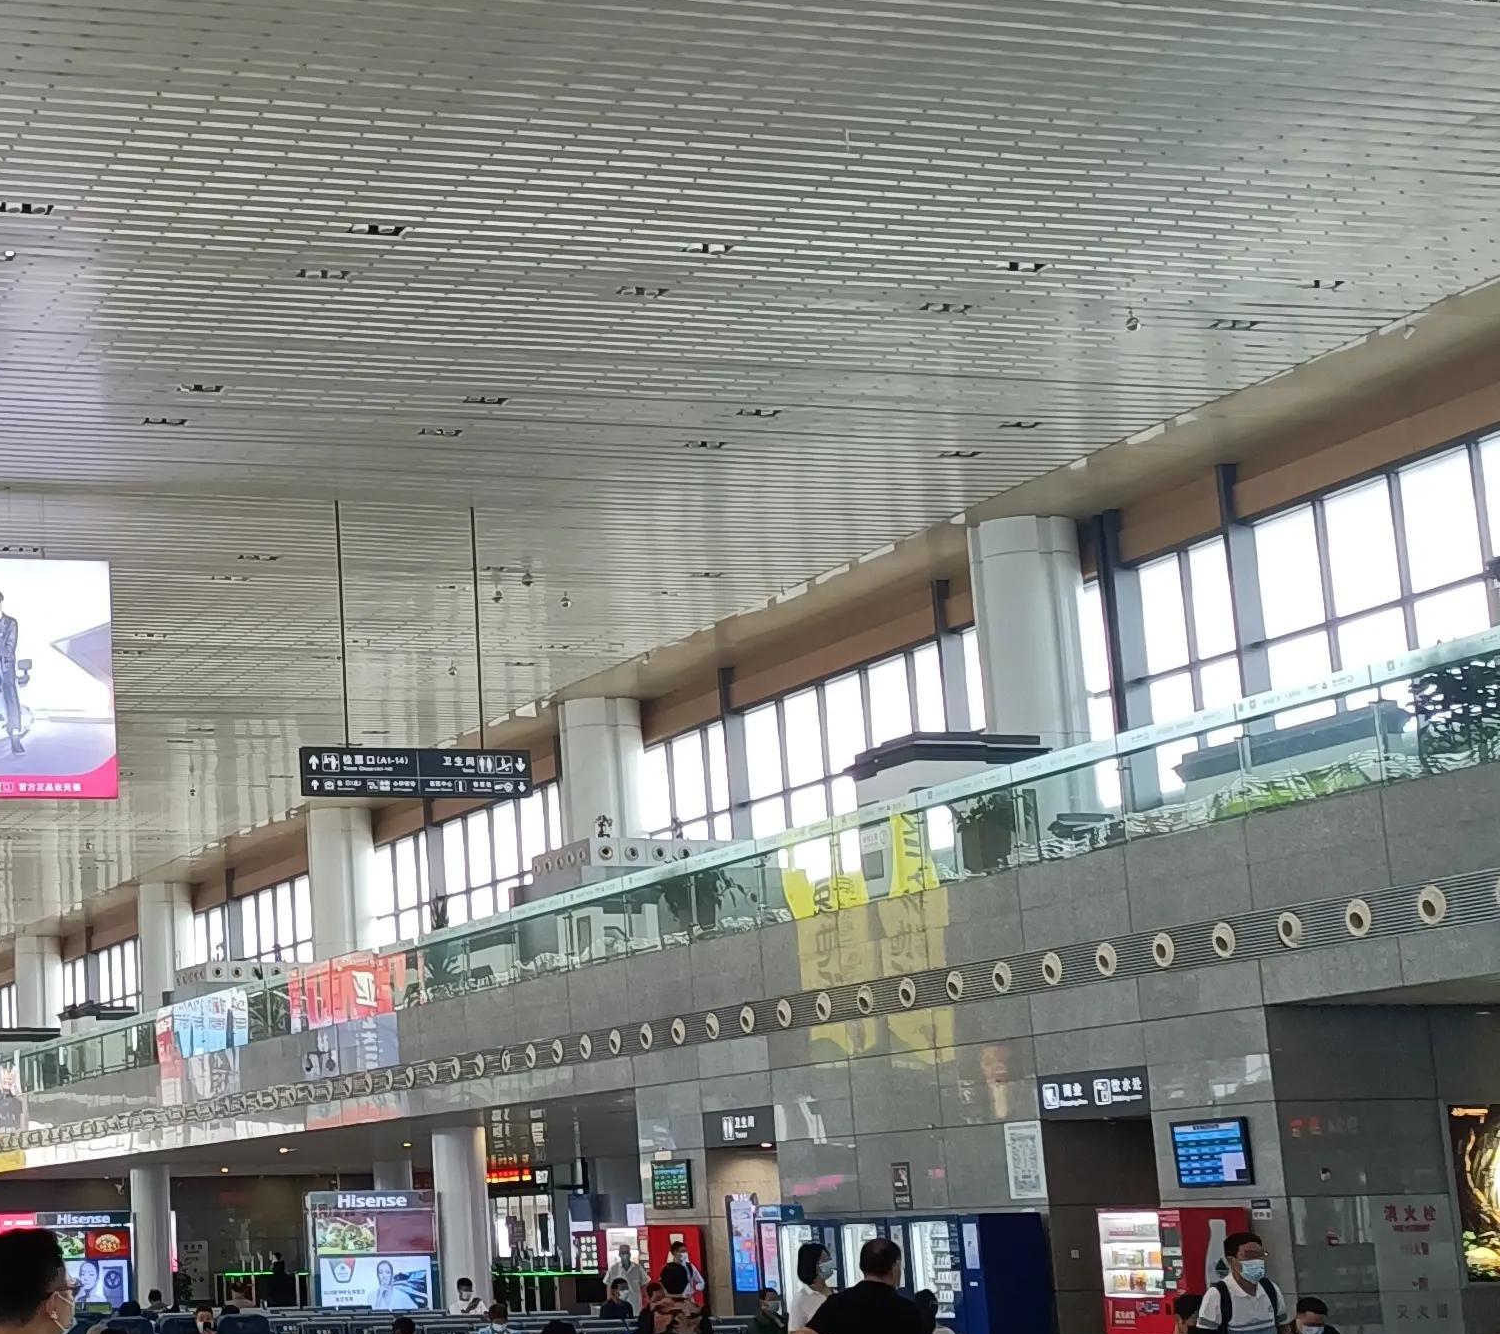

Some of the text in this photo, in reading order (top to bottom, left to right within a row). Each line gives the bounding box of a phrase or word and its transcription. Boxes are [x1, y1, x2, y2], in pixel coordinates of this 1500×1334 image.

[338, 1193, 408, 1209] Hisense
[56, 1213, 110, 1225] Hisense
[1384, 1203, 1436, 1222] 消火栓
